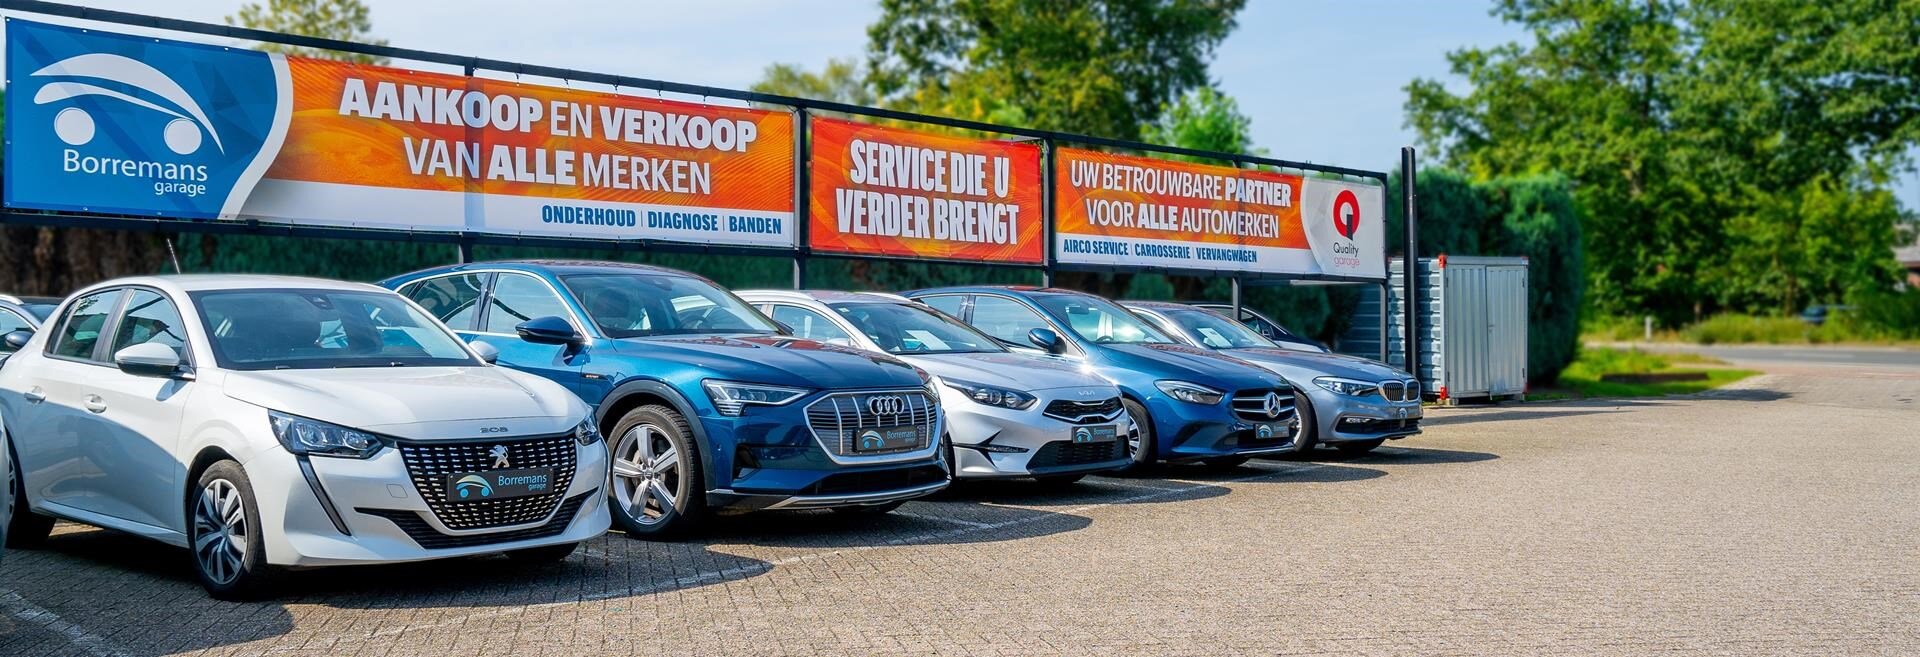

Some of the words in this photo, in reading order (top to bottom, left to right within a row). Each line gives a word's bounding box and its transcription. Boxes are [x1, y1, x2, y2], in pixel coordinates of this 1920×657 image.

[338, 77, 543, 133] AANKOOP
[550, 100, 592, 139] EN
[600, 105, 757, 153] VERKOOP
[63, 148, 208, 183] Borremans
[403, 136, 480, 179] VAN
[487, 144, 576, 186] ALLE
[583, 152, 710, 195] MERKEN
[850, 138, 947, 193] SERVICE
[950, 152, 988, 197] DIE
[993, 156, 1010, 198] U
[154, 181, 206, 197] garage
[1071, 159, 1100, 189] UW
[1102, 163, 1222, 200] BETROUWBARE
[1225, 176, 1292, 208] PARTNER
[542, 204, 636, 227] ONDERHOUD
[647, 211, 719, 232] DIAGNOSE
[729, 215, 782, 235] BANDEN
[835, 187, 930, 240] VERDER
[933, 198, 1019, 245] BRENGT
[1086, 198, 1135, 228] VOOR
[1137, 203, 1179, 231] ALLE
[1180, 207, 1279, 239] AUTOMERKEN
[1063, 239, 1091, 254] AIRCO
[1092, 241, 1129, 256] SERVICE
[1134, 243, 1191, 259] CARROSSERIE
[1195, 247, 1257, 263] VERVANGWAGEN
[1333, 242, 1359, 258] Quality
[1333, 257, 1360, 269] garage
[886, 430, 916, 440] Borremans
[498, 473, 547, 486] Borremans
[527, 483, 547, 491] garage
